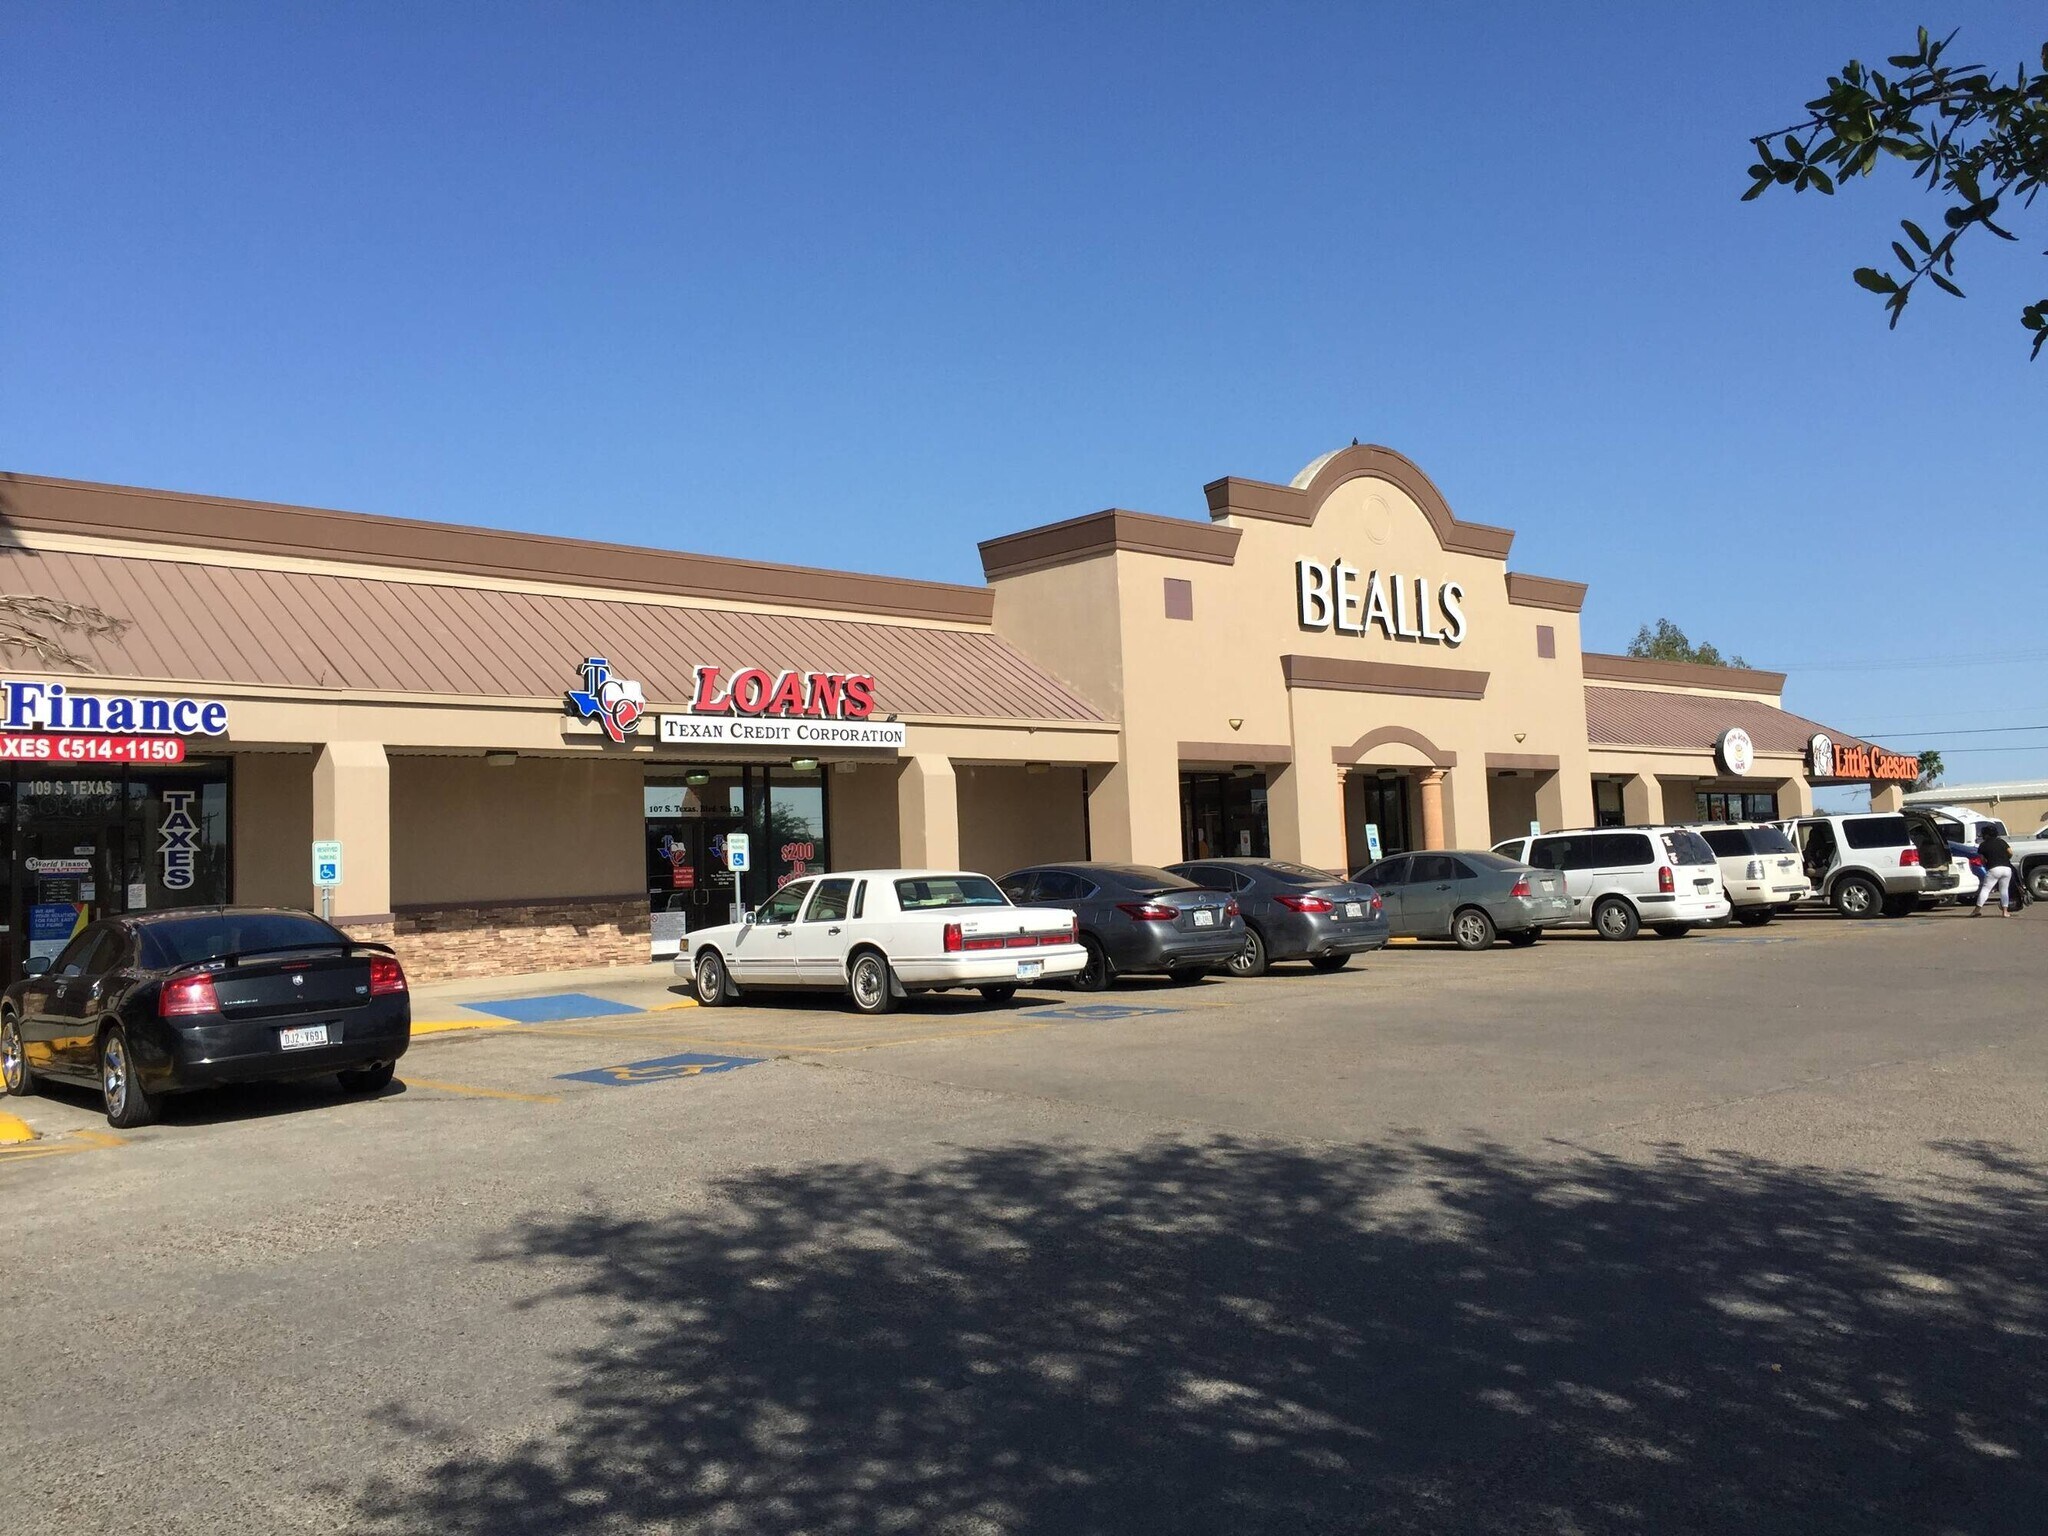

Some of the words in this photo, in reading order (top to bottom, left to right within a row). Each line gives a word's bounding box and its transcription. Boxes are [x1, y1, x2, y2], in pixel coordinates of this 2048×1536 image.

[1296, 560, 1467, 645] BEALLS
[693, 667, 875, 718] LOANS
[3, 681, 228, 734] Finance
[664, 720, 723, 739] TEXAN
[730, 722, 791, 740] CREDIT
[796, 724, 903, 743] CORPORATION
[1833, 744, 1870, 778] Little
[1870, 745, 1919, 780] Caesars
[28, 780, 51, 796] 109
[55, 780, 67, 796] S.
[71, 780, 113, 795] TEXAS
[649, 805, 663, 813] 107
[664, 805, 673, 813] S.
[163, 792, 195, 888] TAXES
[781, 842, 814, 861] $200
[35, 860, 59, 868] World
[793, 860, 806, 873] to
